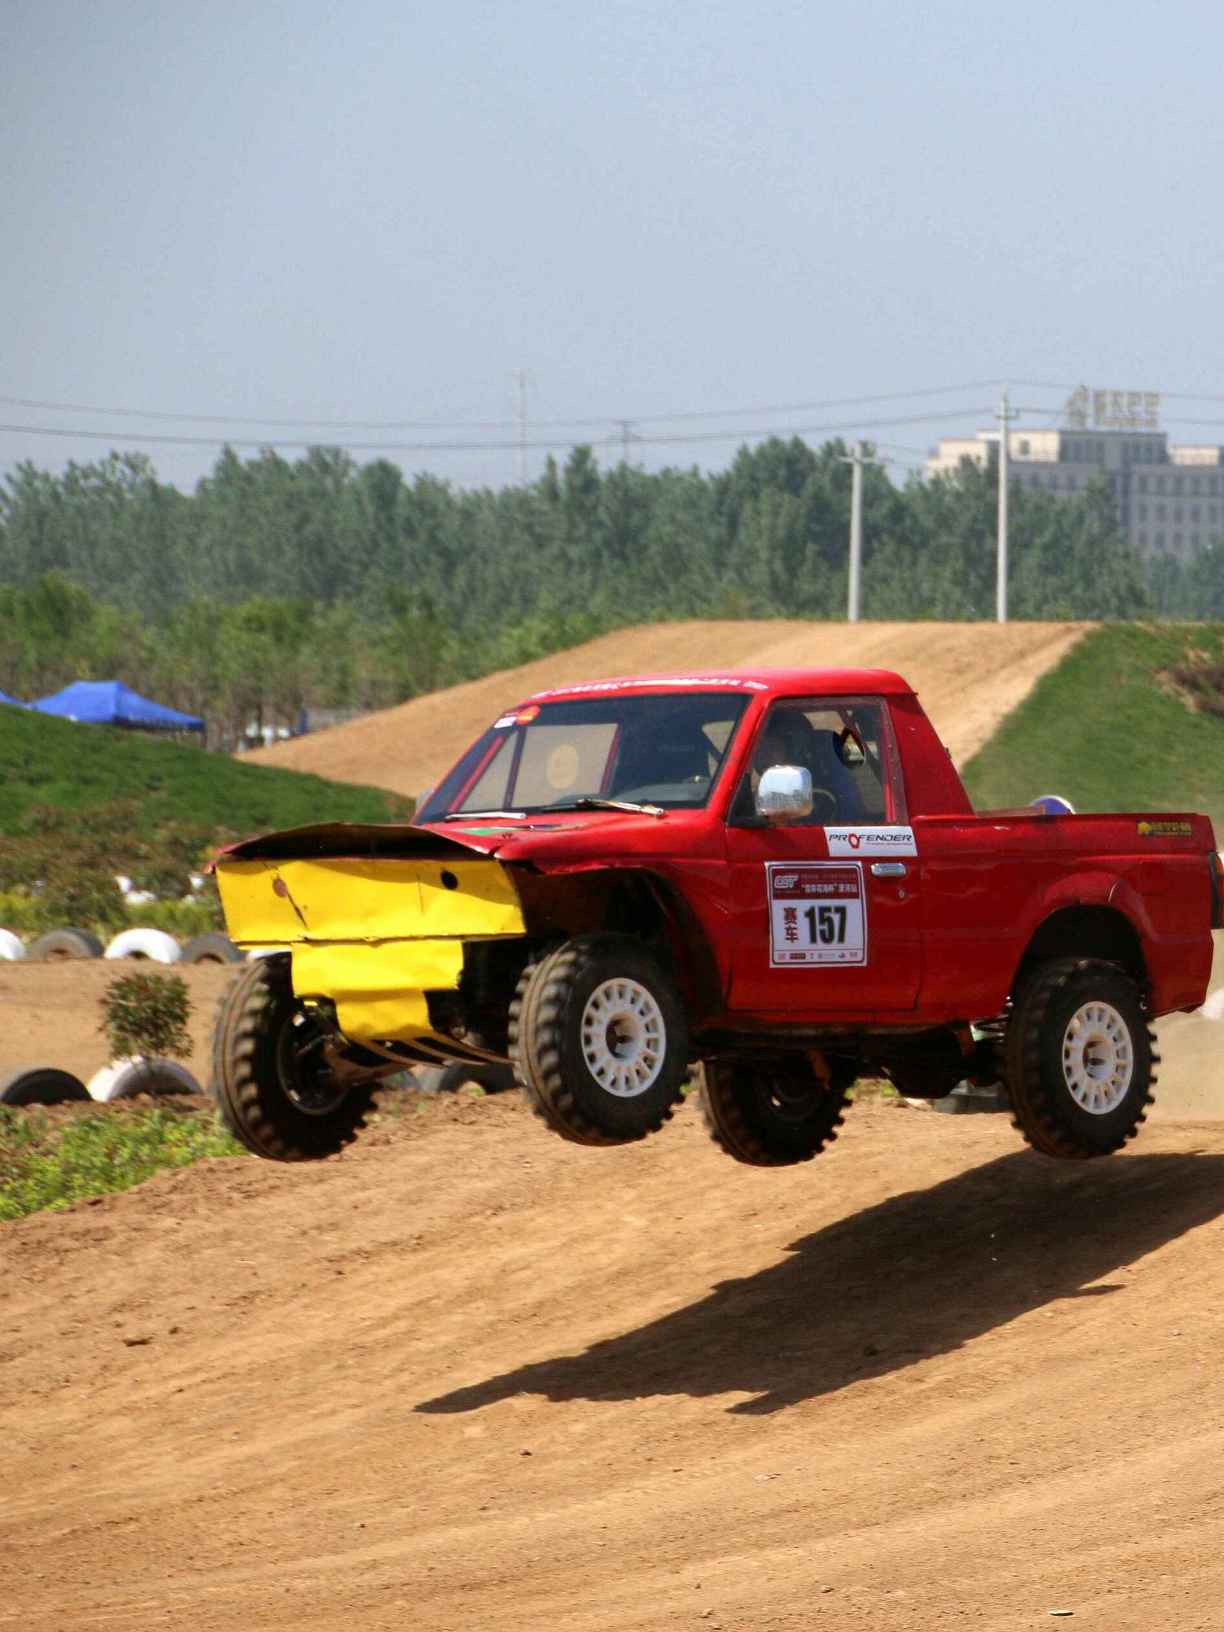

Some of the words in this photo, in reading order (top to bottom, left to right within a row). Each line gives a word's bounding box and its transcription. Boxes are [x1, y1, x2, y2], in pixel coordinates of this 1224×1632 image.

[828, 832, 913, 849] PROFENDER
[784, 907, 799, 943] 赛车
[804, 905, 848, 945] 157
